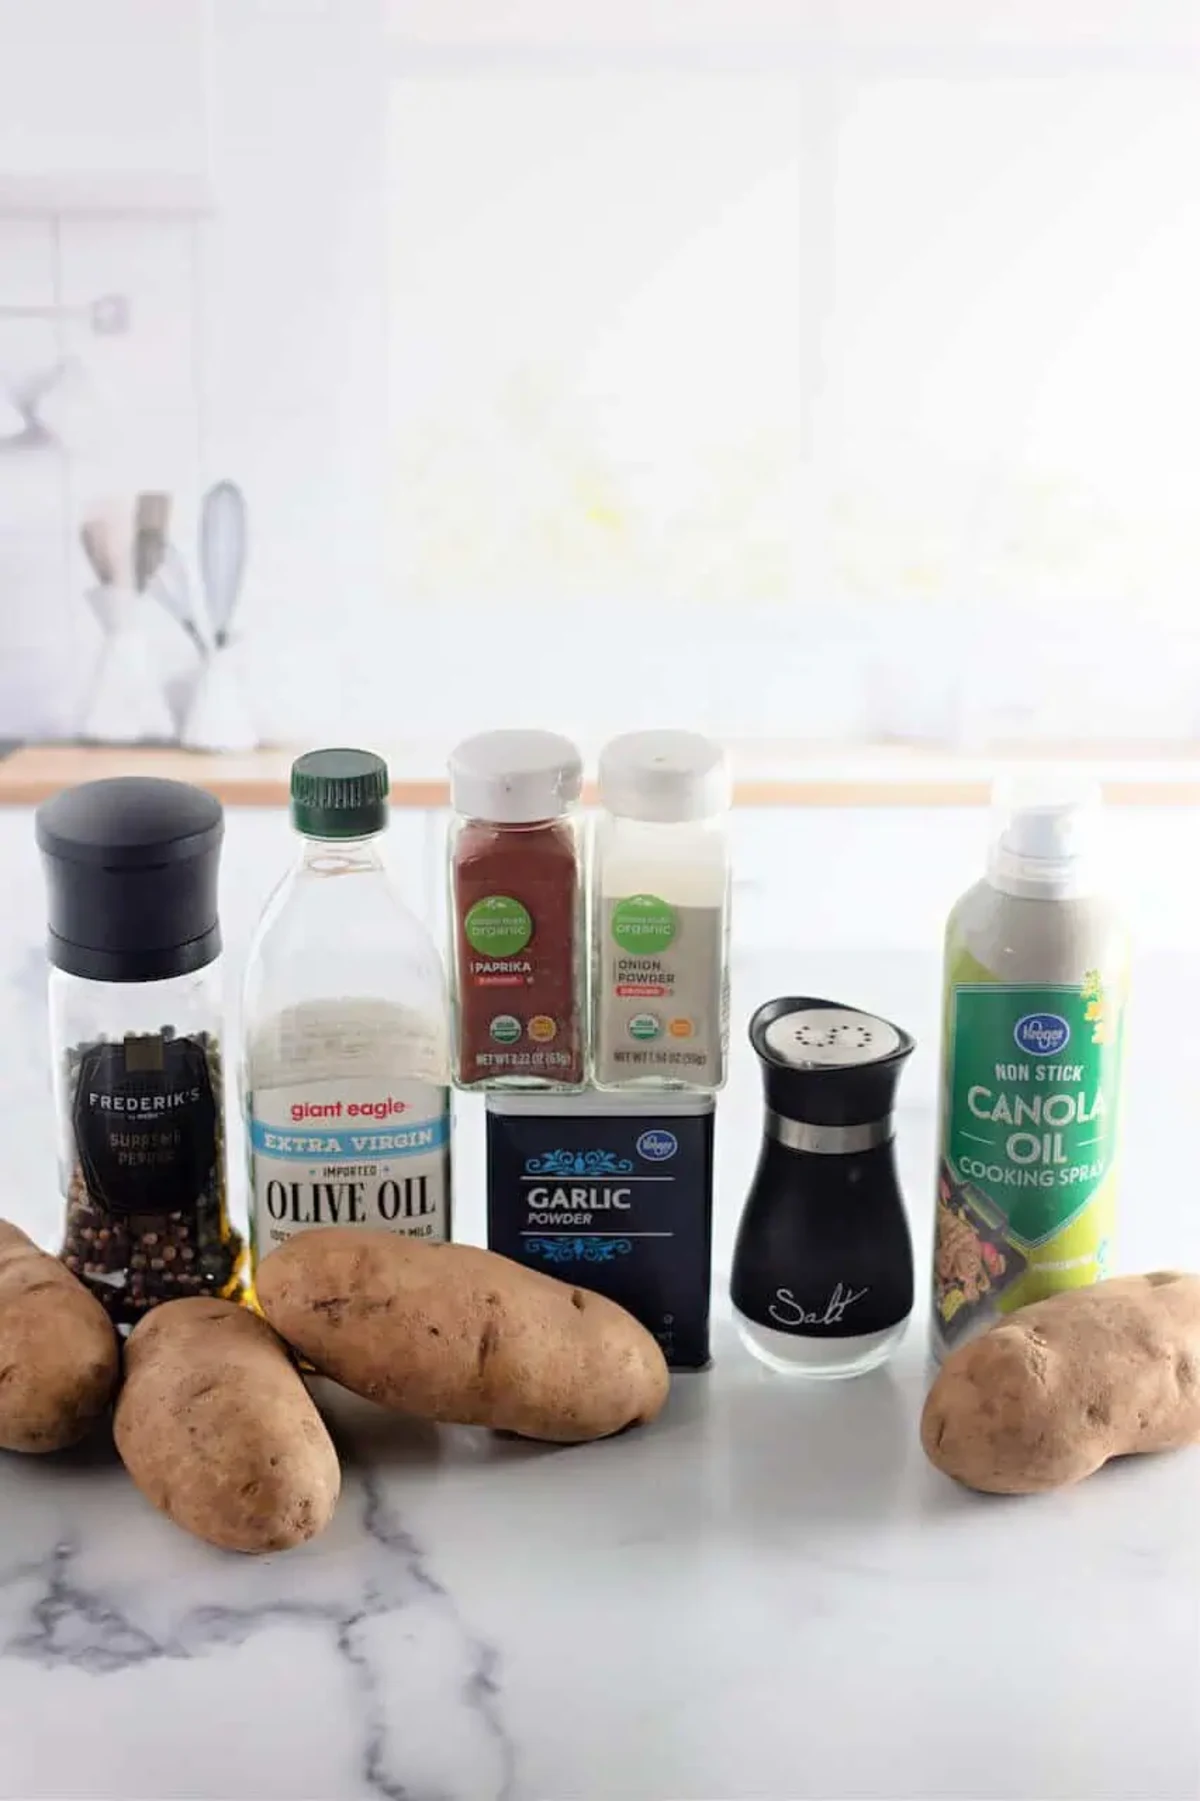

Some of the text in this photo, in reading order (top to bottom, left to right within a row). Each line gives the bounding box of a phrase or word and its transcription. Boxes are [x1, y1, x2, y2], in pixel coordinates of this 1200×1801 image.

[475, 961, 532, 973] PAPRIKA
[618, 960, 662, 971] ONION
[618, 973, 676, 984] POWDER
[1022, 1020, 1065, 1049] Kroger
[476, 1053, 493, 1066] NET
[995, 1064, 1085, 1082] NON STICK
[89, 1087, 201, 1111] FREDERIK'S
[291, 1097, 406, 1122] giant eagle
[967, 1085, 1107, 1127] CANOLA
[264, 1129, 433, 1152] EXTRA VIRGIN
[642, 1135, 673, 1156] Kroger
[1006, 1132, 1069, 1165] OIL
[323, 1164, 378, 1178] IMPORTED
[959, 1156, 1055, 1187] COOKING
[267, 1175, 436, 1224] OLIVE OIL
[527, 1188, 632, 1210] GARLIC
[527, 1212, 594, 1225] POWDER
[768, 1281, 869, 1325] Salt
